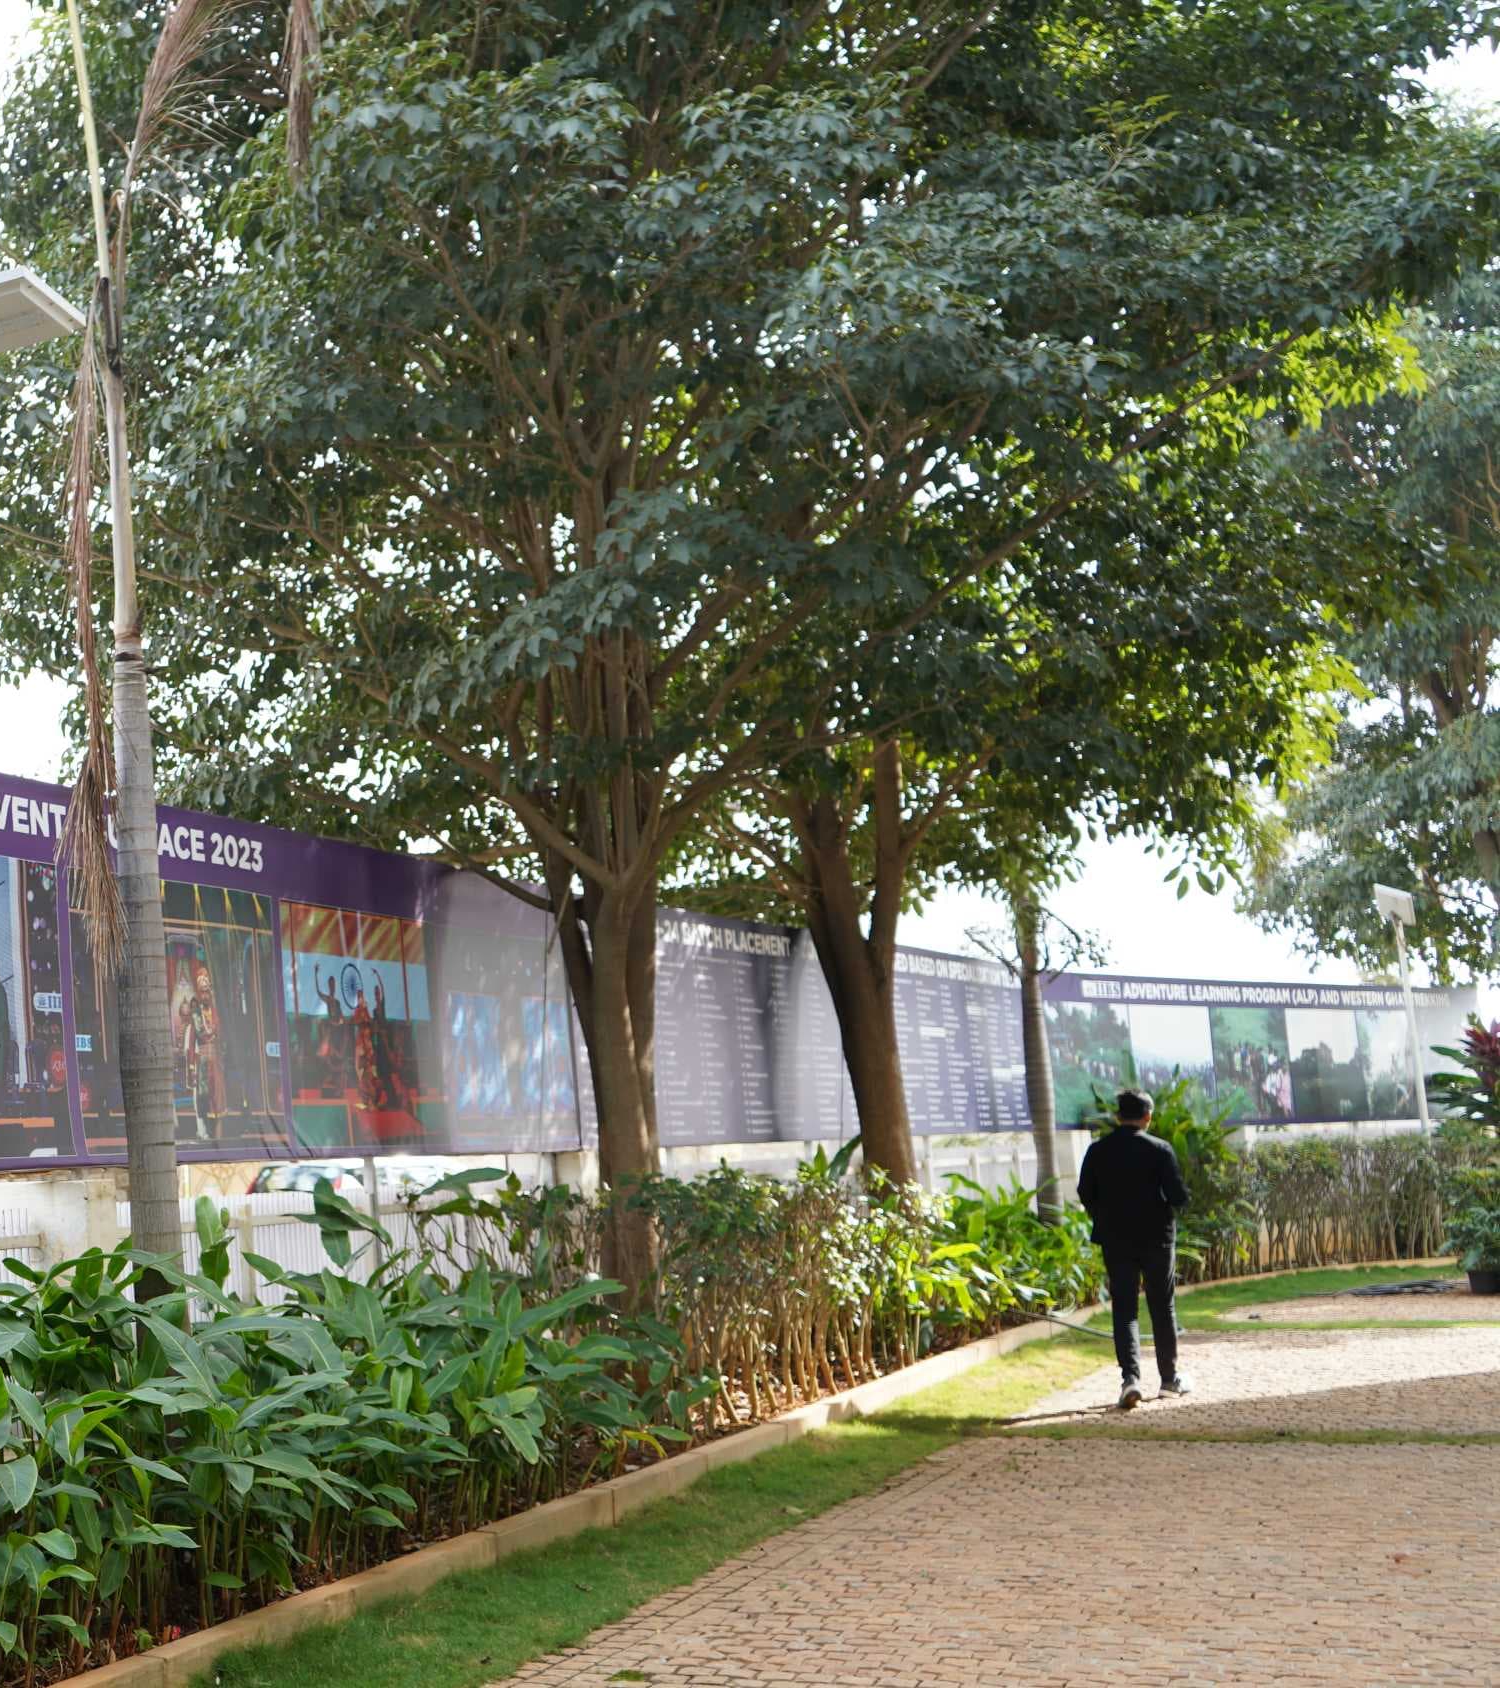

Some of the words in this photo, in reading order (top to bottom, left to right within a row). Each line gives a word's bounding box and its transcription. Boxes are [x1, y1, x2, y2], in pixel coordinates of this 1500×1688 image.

[210, 832, 264, 873] 2023
[725, 928, 791, 957] PLACEMENT
[1123, 982, 1189, 1001] ADVENTURE
[1189, 985, 1241, 1003] LEARNING
[1243, 987, 1290, 1005] PROGRAM
[1291, 988, 1319, 1006] (ALP)
[1320, 989, 1340, 1006] AND
[1340, 990, 1385, 1007] WESTERN
